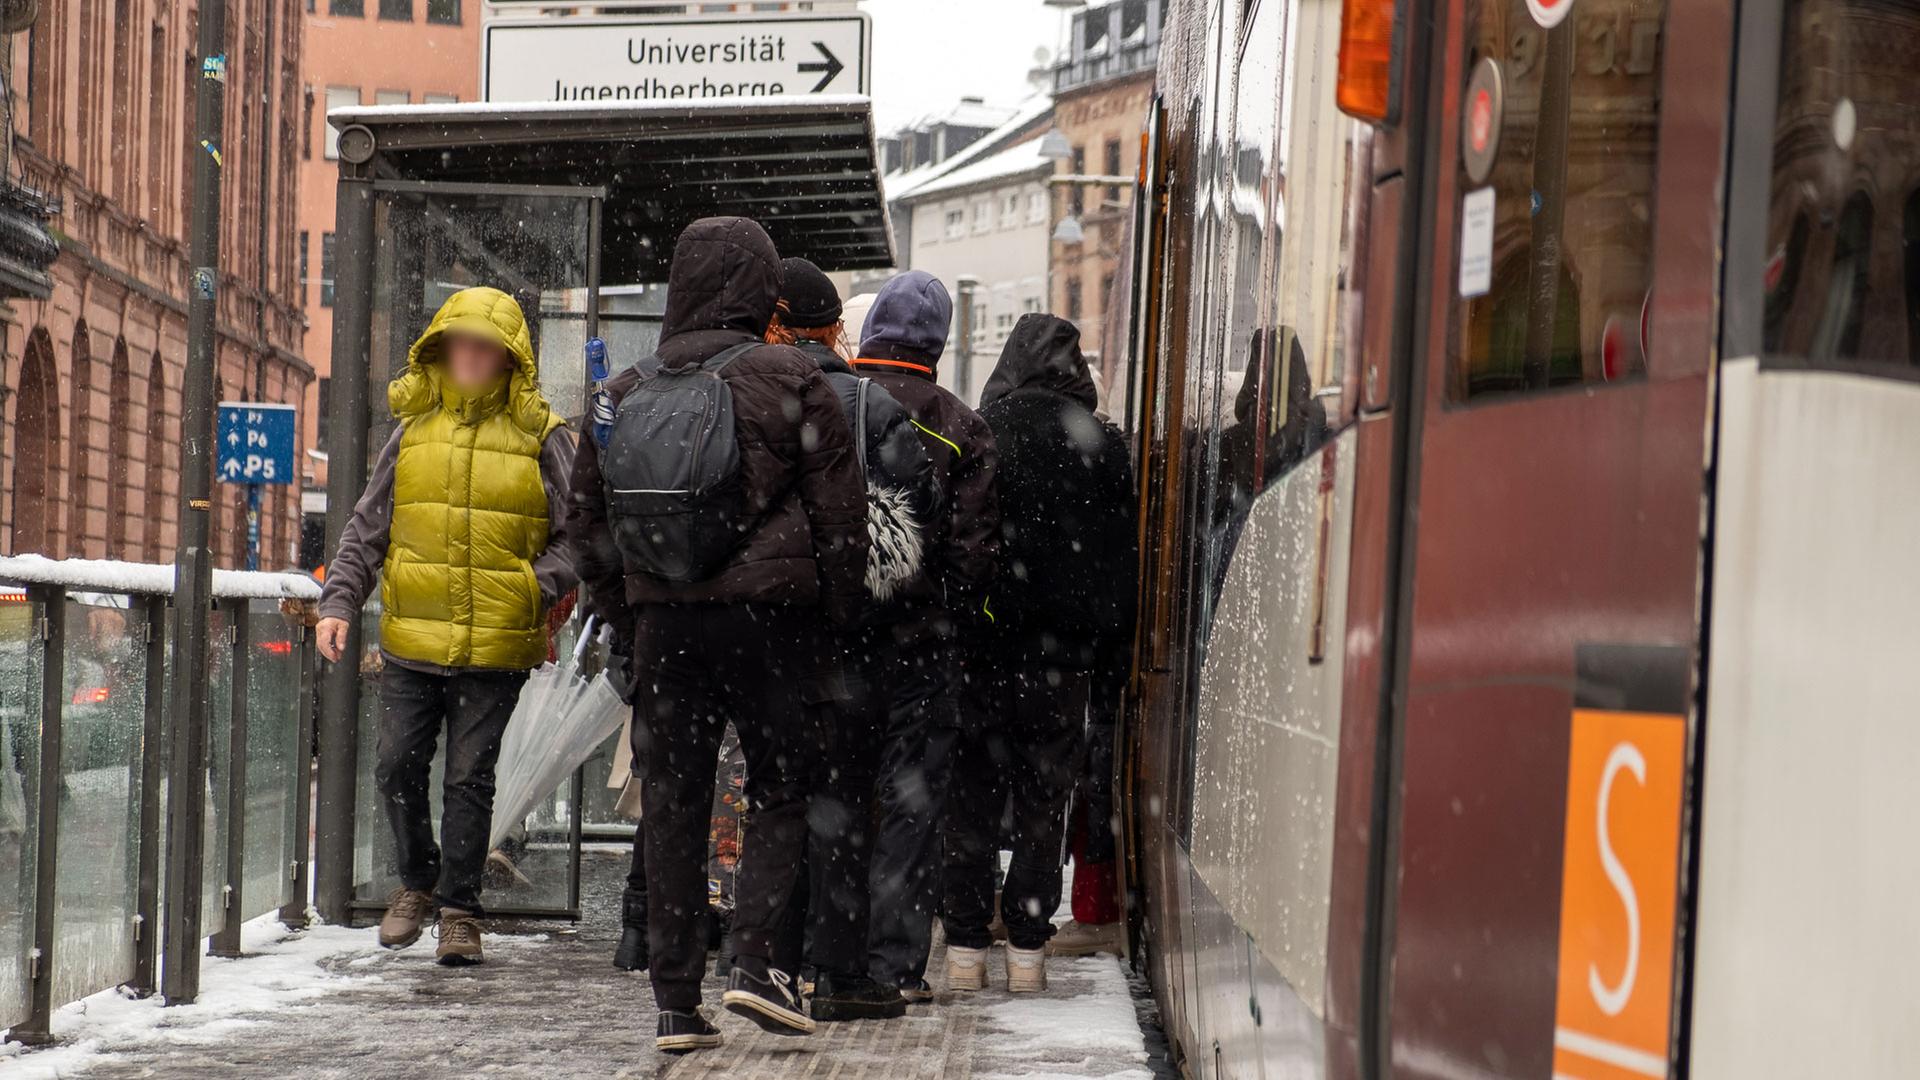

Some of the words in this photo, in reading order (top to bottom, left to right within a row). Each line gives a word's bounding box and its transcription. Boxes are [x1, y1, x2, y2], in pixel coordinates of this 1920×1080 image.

[627, 35, 785, 65] Universität
[248, 430, 268, 448] P6
[246, 455, 275, 480] P5
[1588, 741, 1647, 1017] S
